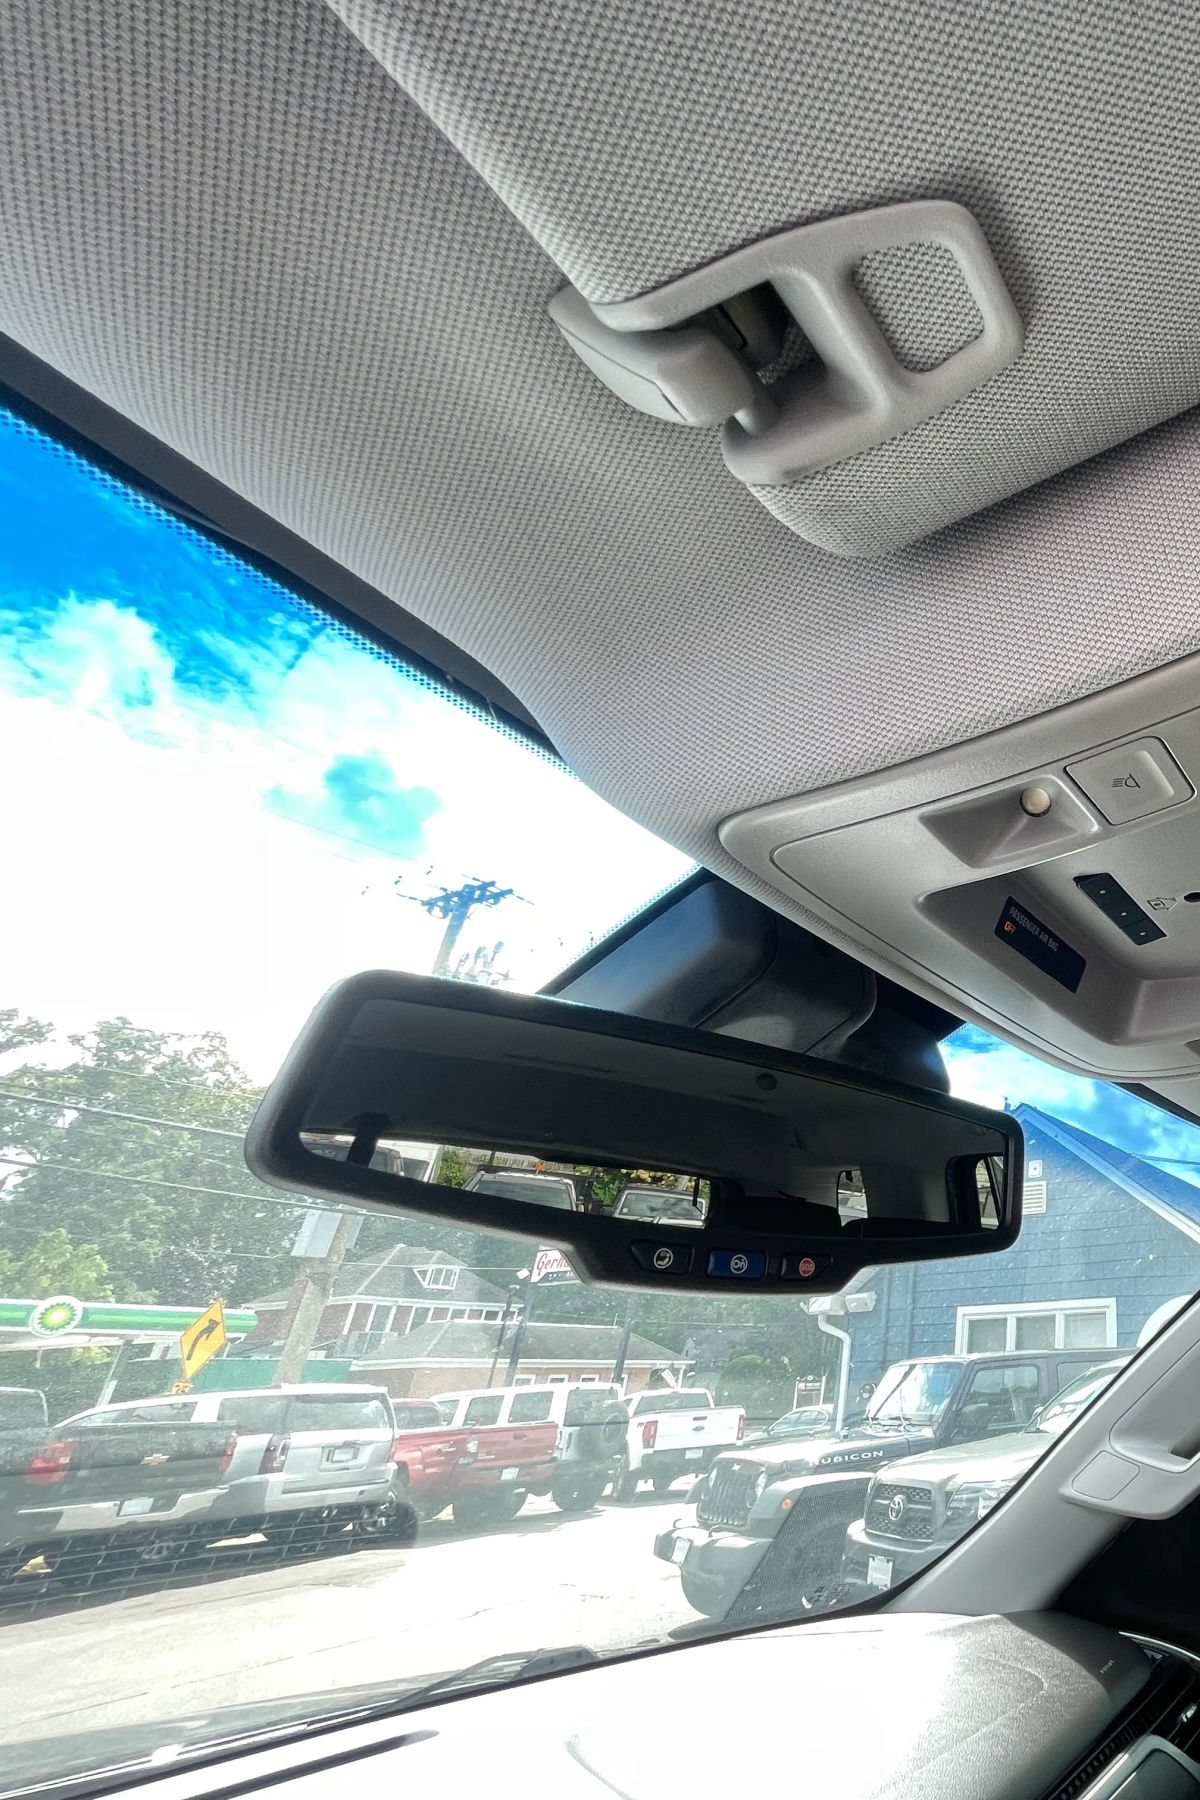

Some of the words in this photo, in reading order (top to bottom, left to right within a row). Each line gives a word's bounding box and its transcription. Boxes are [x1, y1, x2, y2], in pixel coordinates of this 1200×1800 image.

[1004, 921, 1017, 935] OFF
[1009, 906, 1040, 936] PASSENGER
[809, 1450, 884, 1466] RUBICON
